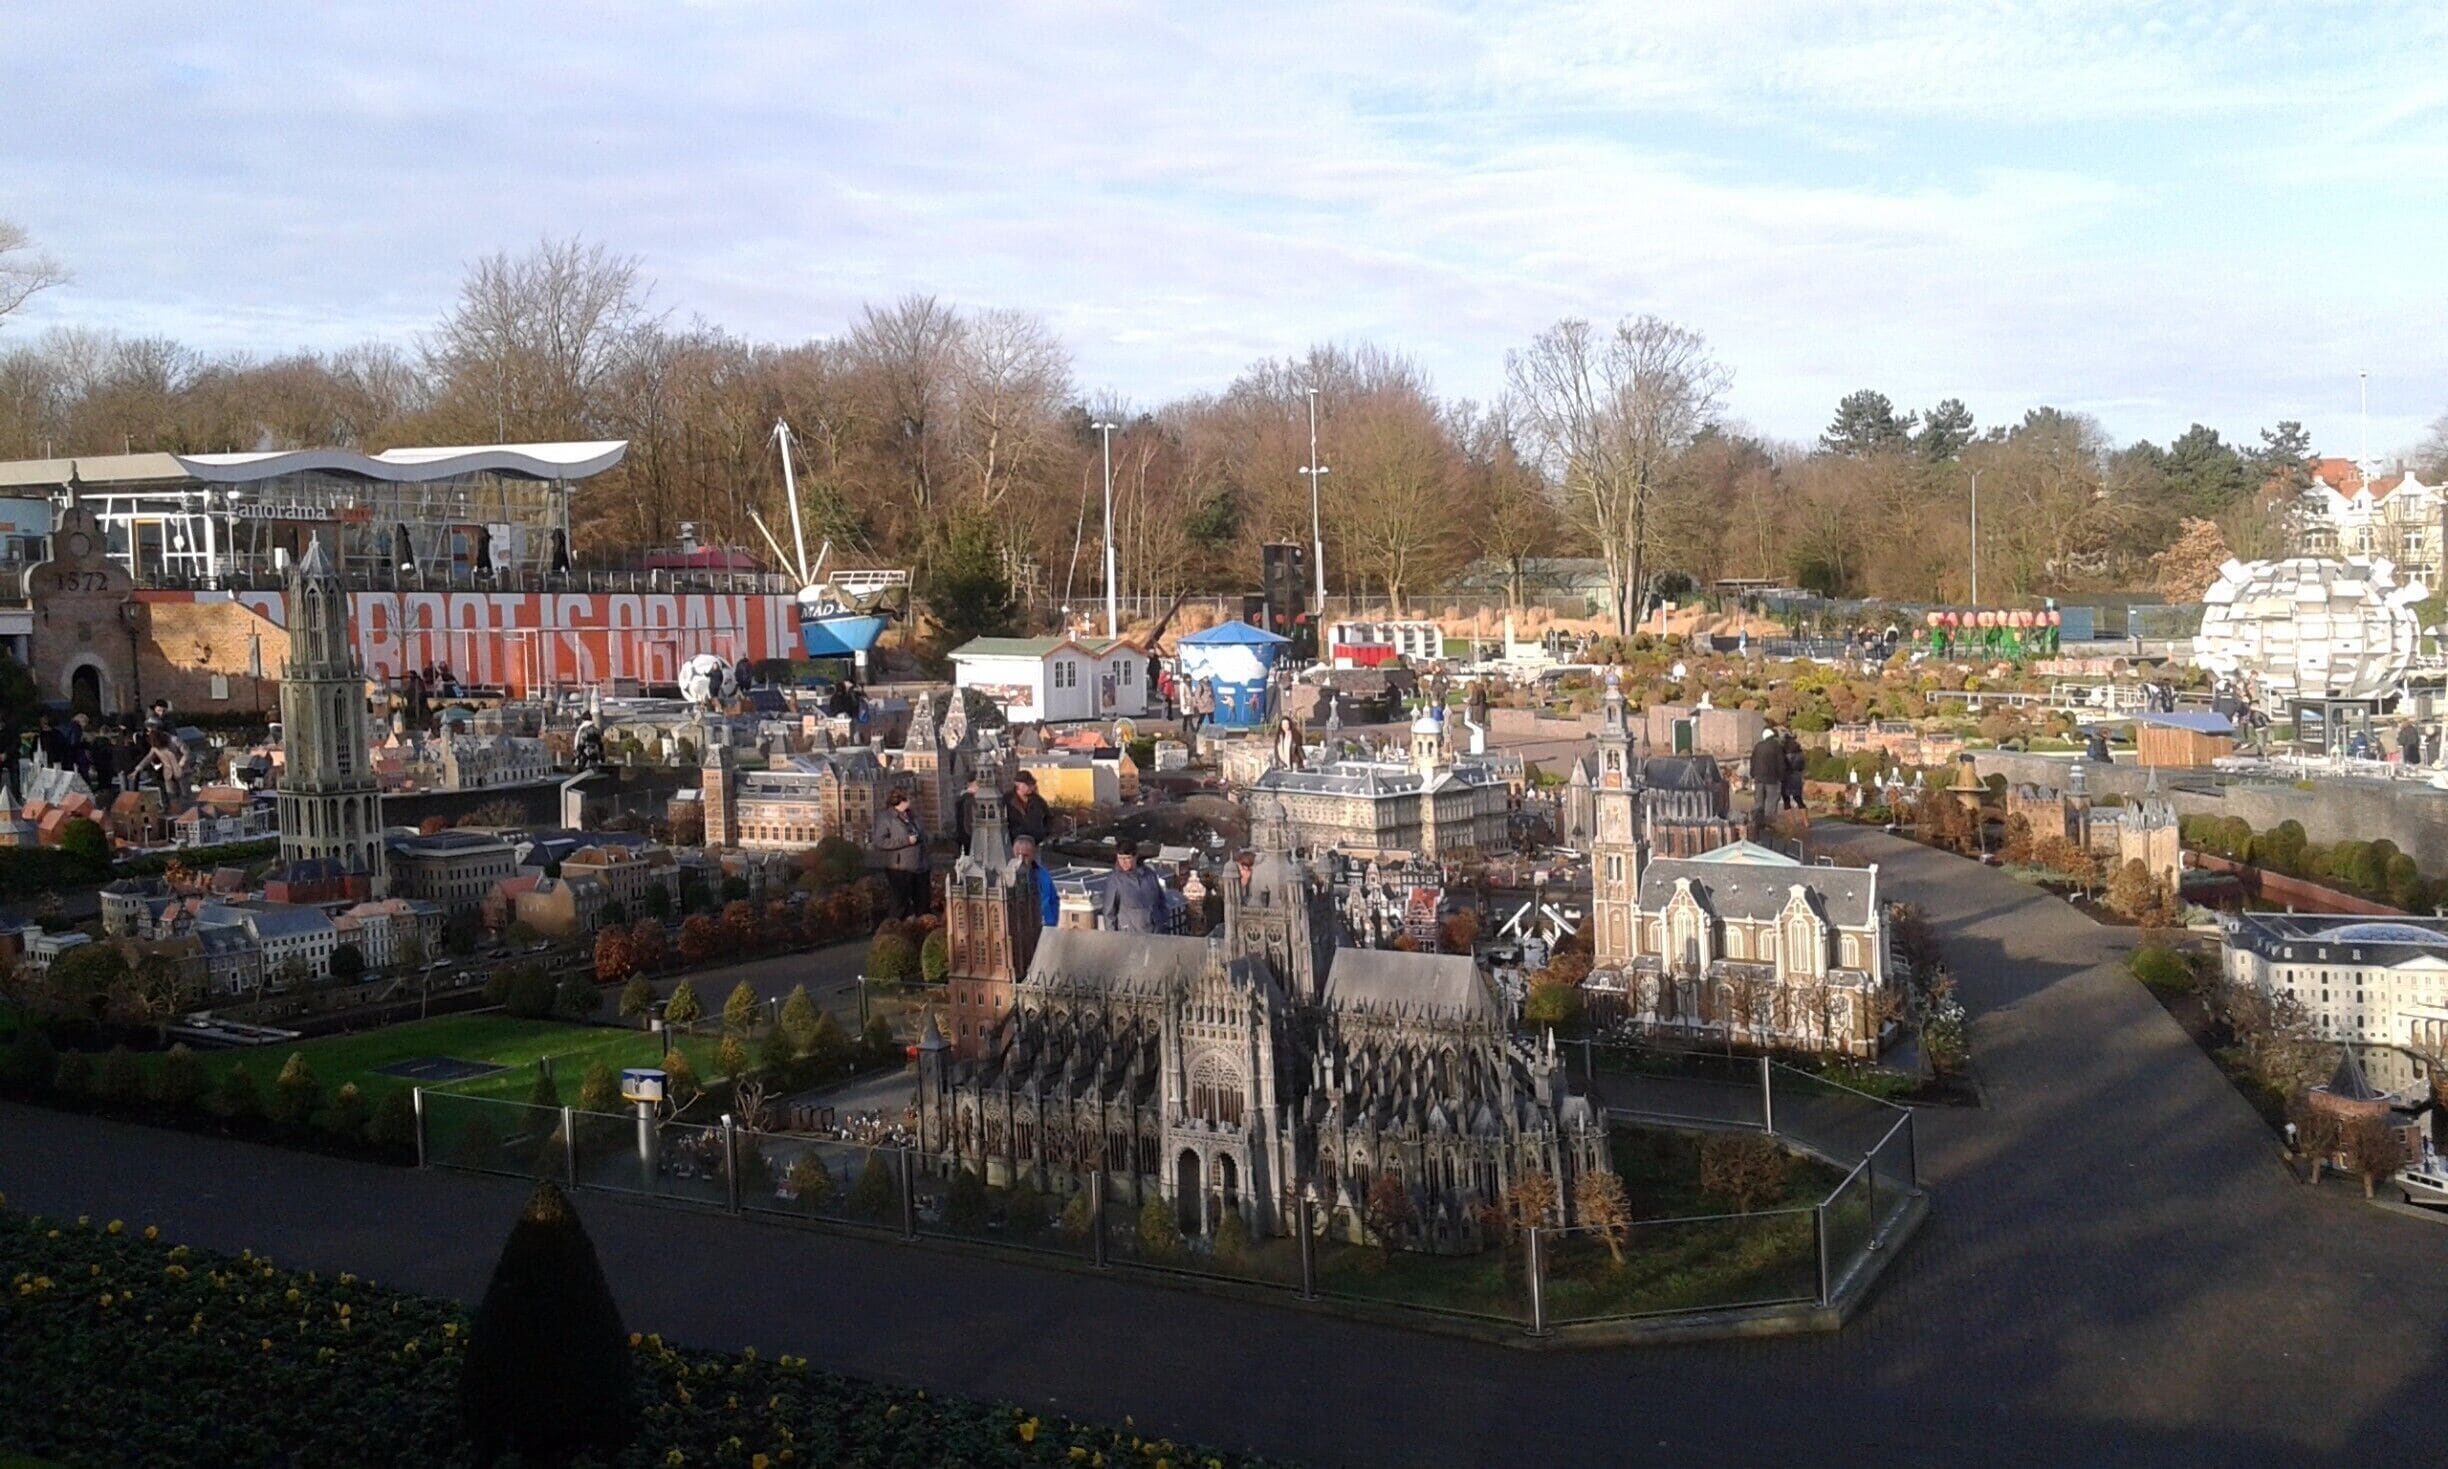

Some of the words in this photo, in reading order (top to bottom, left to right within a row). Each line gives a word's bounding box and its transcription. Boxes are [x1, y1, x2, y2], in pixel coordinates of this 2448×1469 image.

[227, 500, 327, 520] Panorama
[57, 571, 108, 592] 1572
[801, 604, 835, 618] MAD
[347, 592, 525, 686] ROOT
[540, 593, 596, 682] IS
